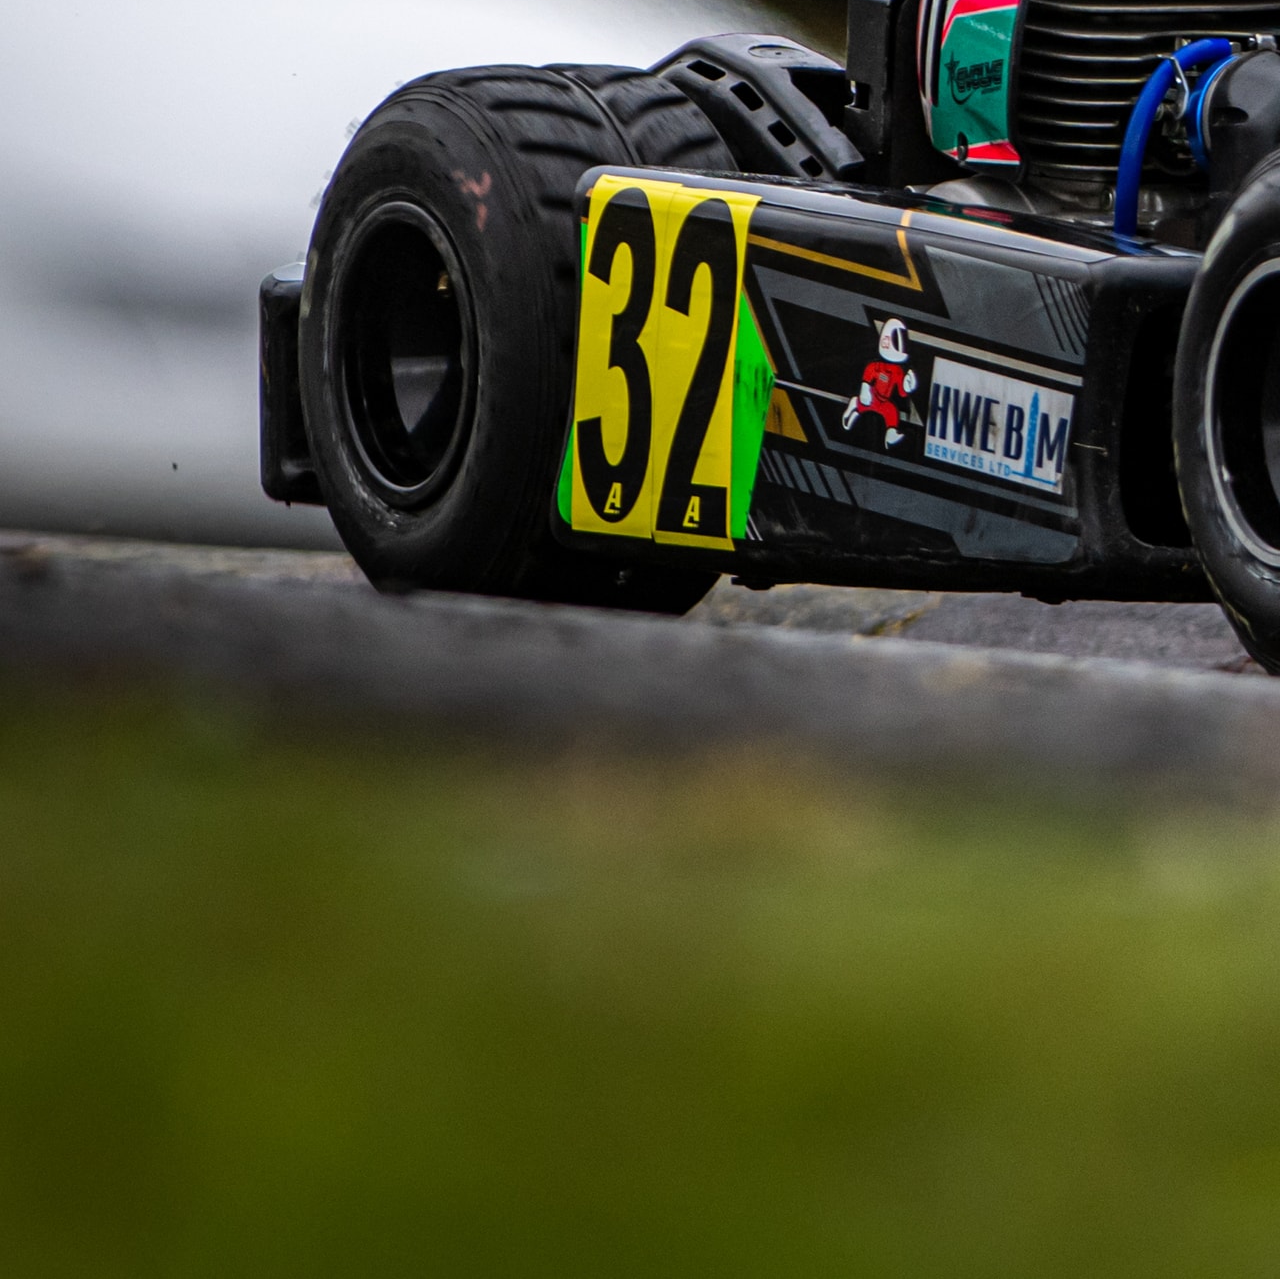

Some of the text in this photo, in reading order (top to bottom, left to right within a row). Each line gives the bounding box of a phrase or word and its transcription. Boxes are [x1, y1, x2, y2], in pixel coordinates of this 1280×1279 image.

[576, 187, 738, 537] 32
[926, 442, 1013, 478] SERVICES LTD
